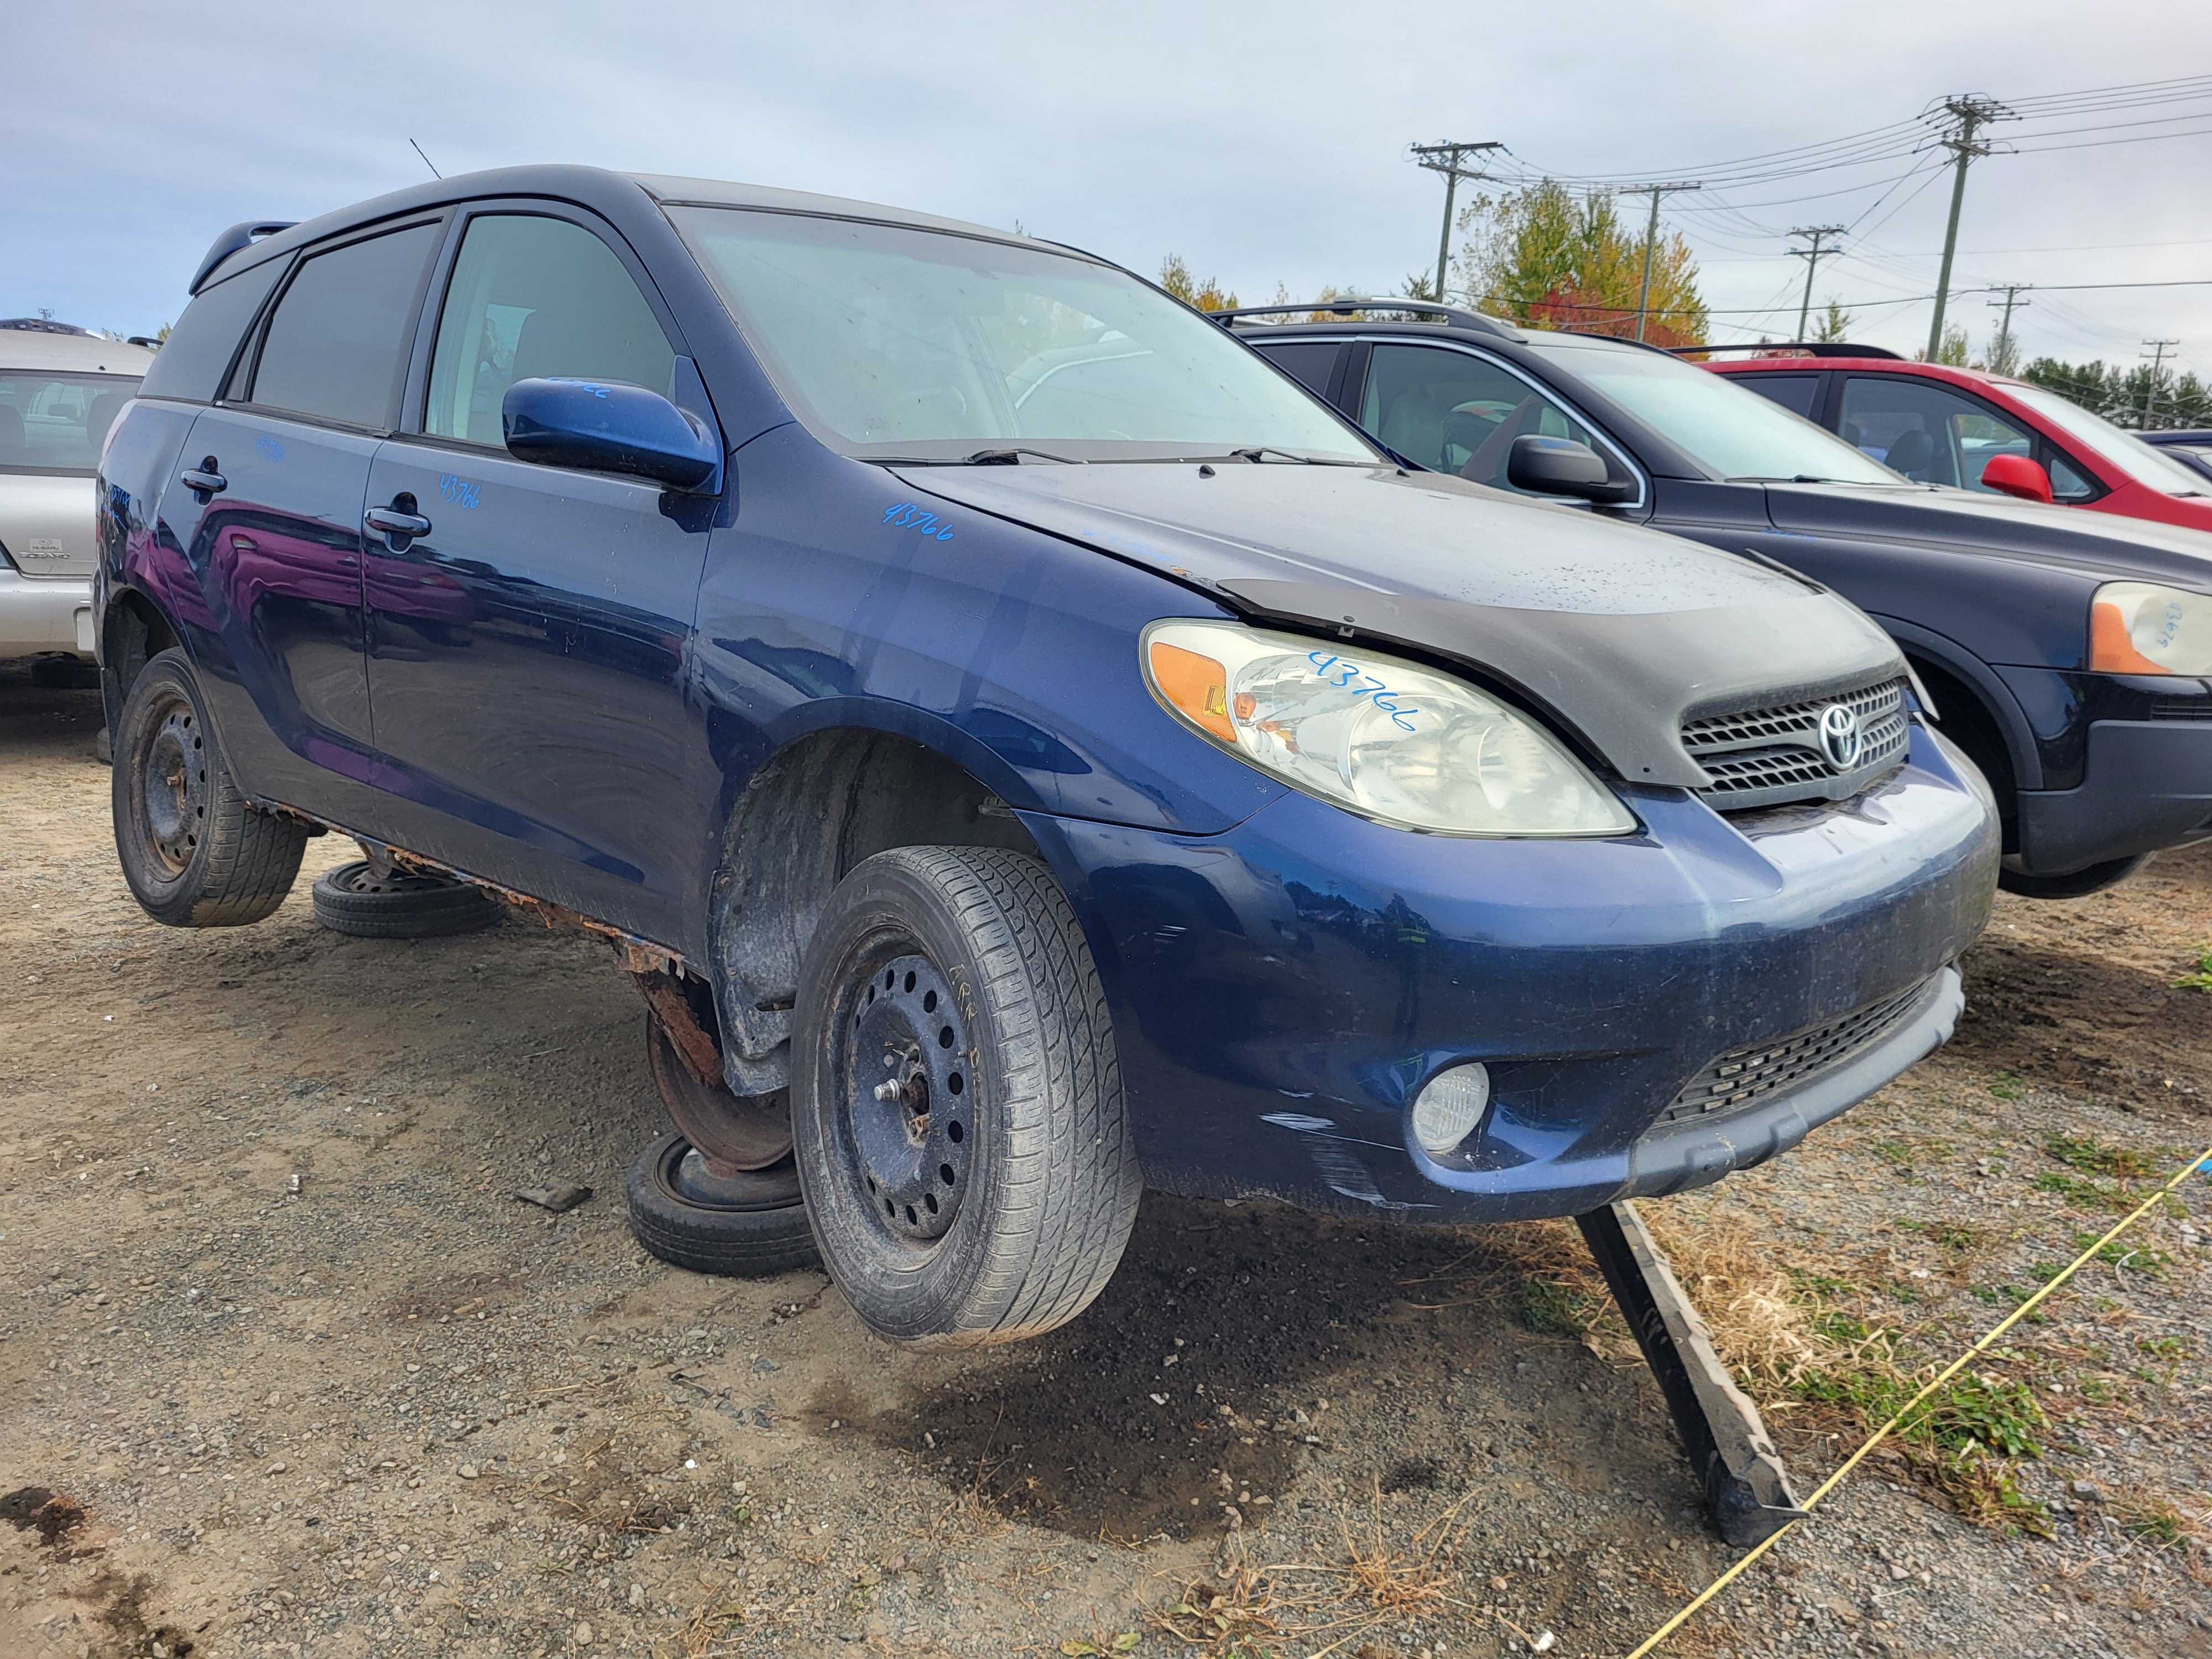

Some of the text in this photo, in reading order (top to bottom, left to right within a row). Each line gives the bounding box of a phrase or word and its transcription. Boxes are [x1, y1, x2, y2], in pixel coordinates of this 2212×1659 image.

[440, 473, 481, 509] 43766
[883, 503, 954, 540] 43766
[1308, 650, 1418, 732] 43766
